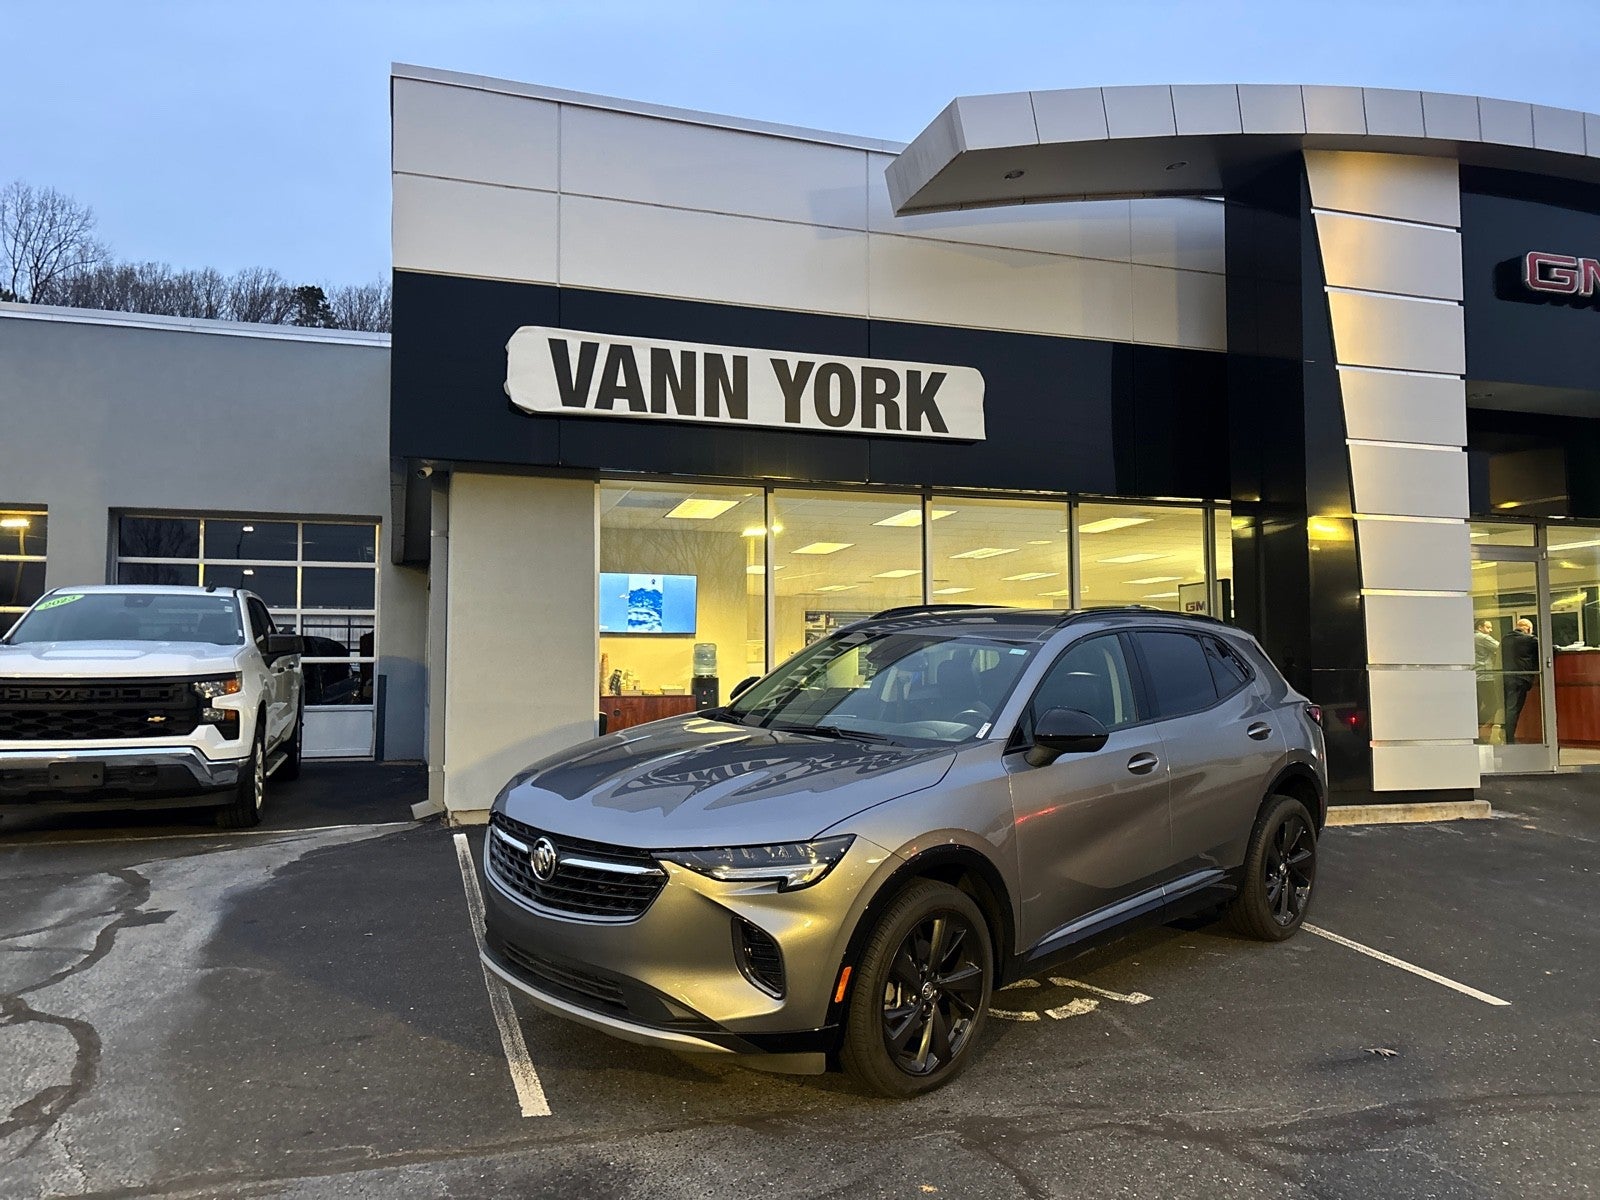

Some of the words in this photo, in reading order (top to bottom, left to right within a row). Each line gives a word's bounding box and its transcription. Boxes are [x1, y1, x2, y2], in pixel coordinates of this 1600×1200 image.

[548, 338, 748, 419] VANN
[770, 357, 949, 434] YORK
[0, 686, 184, 700] HEVROLET
